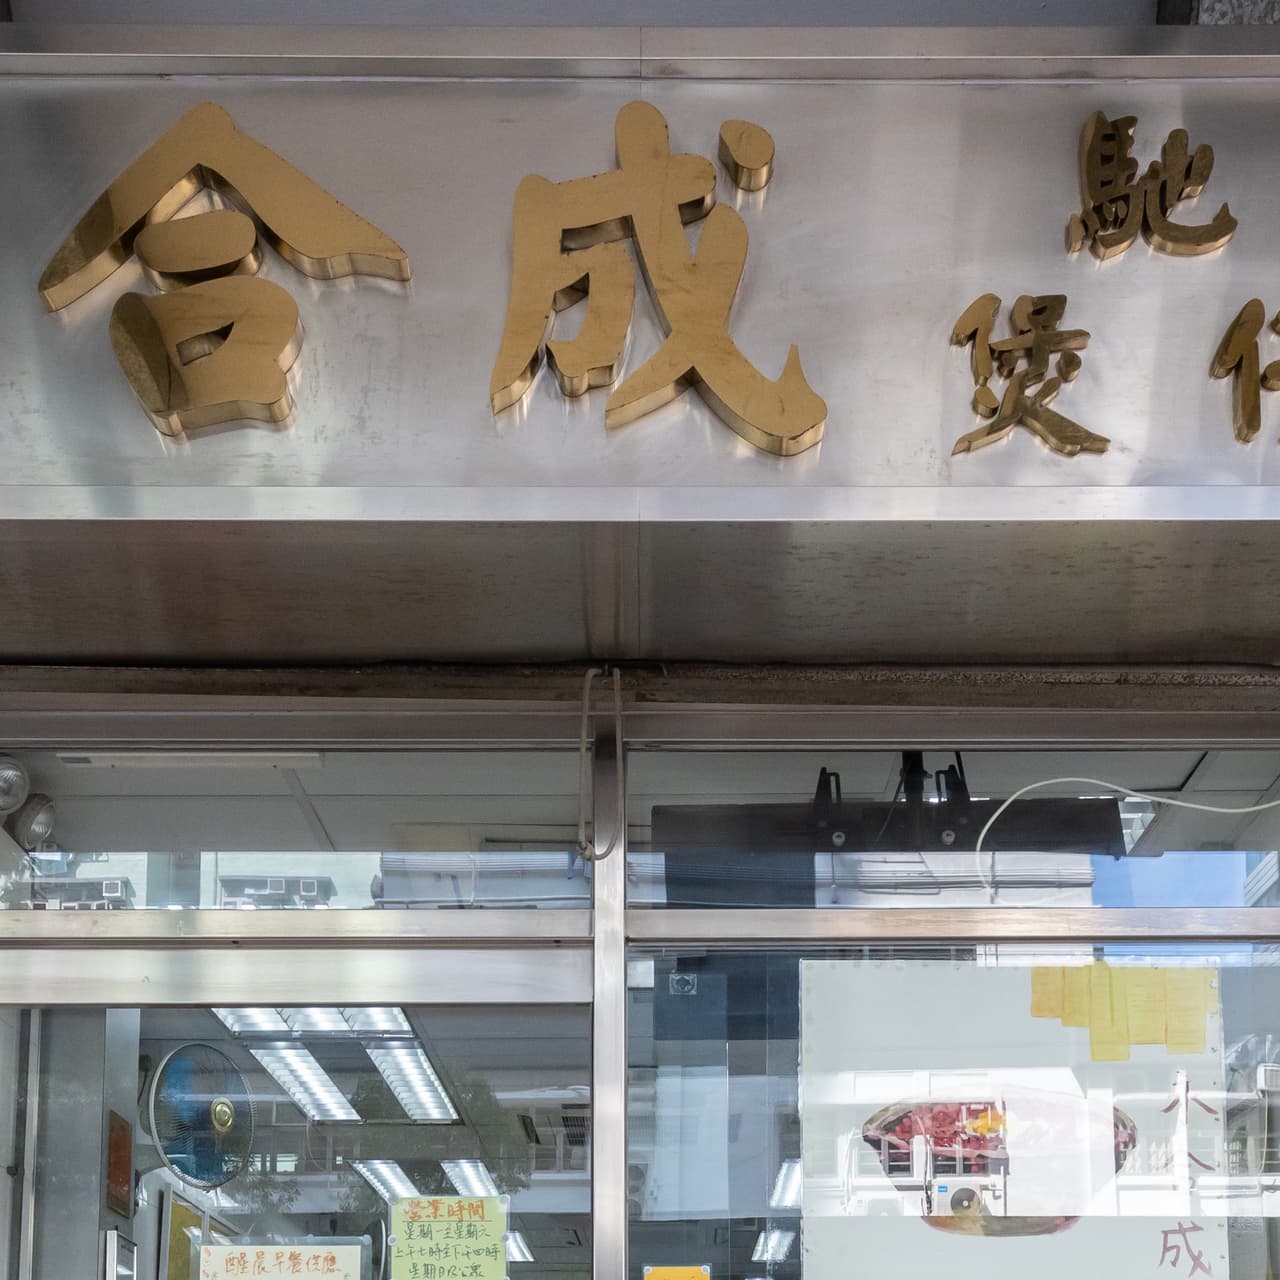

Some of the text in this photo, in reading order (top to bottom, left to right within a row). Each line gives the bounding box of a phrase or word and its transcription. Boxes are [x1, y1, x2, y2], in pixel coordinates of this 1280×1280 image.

[404, 1199, 486, 1221] 營業時間
[403, 1221, 491, 1240] 星期一至星期六
